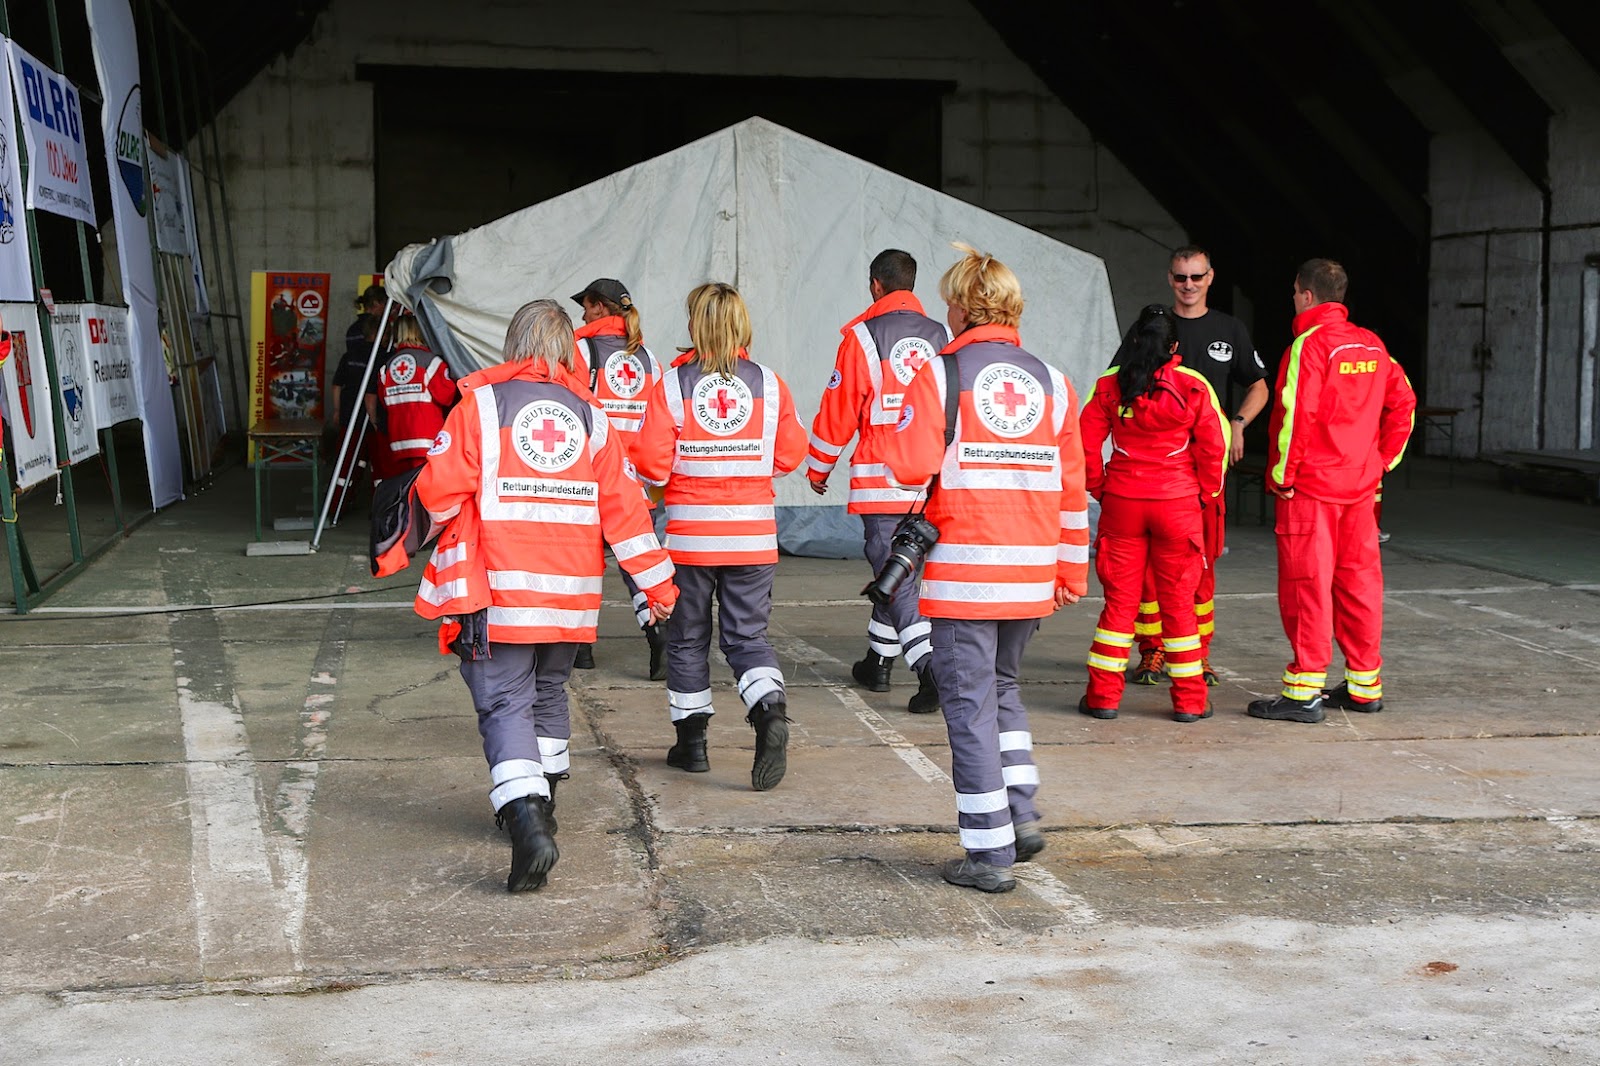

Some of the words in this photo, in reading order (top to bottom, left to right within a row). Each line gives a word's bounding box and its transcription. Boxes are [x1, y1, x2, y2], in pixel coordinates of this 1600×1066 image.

[20, 58, 80, 144] DLRG
[119, 131, 140, 163] DLRG
[273, 275, 324, 287] DLRG
[255, 341, 264, 395] Sicherheit
[1338, 360, 1378, 375] DLRG
[698, 378, 747, 399] DEUTSCHES
[981, 369, 1037, 395] DEUTSCHES
[520, 406, 578, 432] DEUTSCHES
[698, 404, 720, 430] ROTES
[723, 405, 748, 430] KREUZ
[981, 398, 1009, 430] ROTES
[1013, 401, 1039, 431] KREUZ
[519, 435, 547, 465] ROTES
[550, 438, 579, 466] KREUZ
[679, 443, 761, 455] Rettungshundestaffel
[963, 447, 1055, 461] Rettungshundestaffel
[502, 481, 594, 496] Rettungshundestaffel
